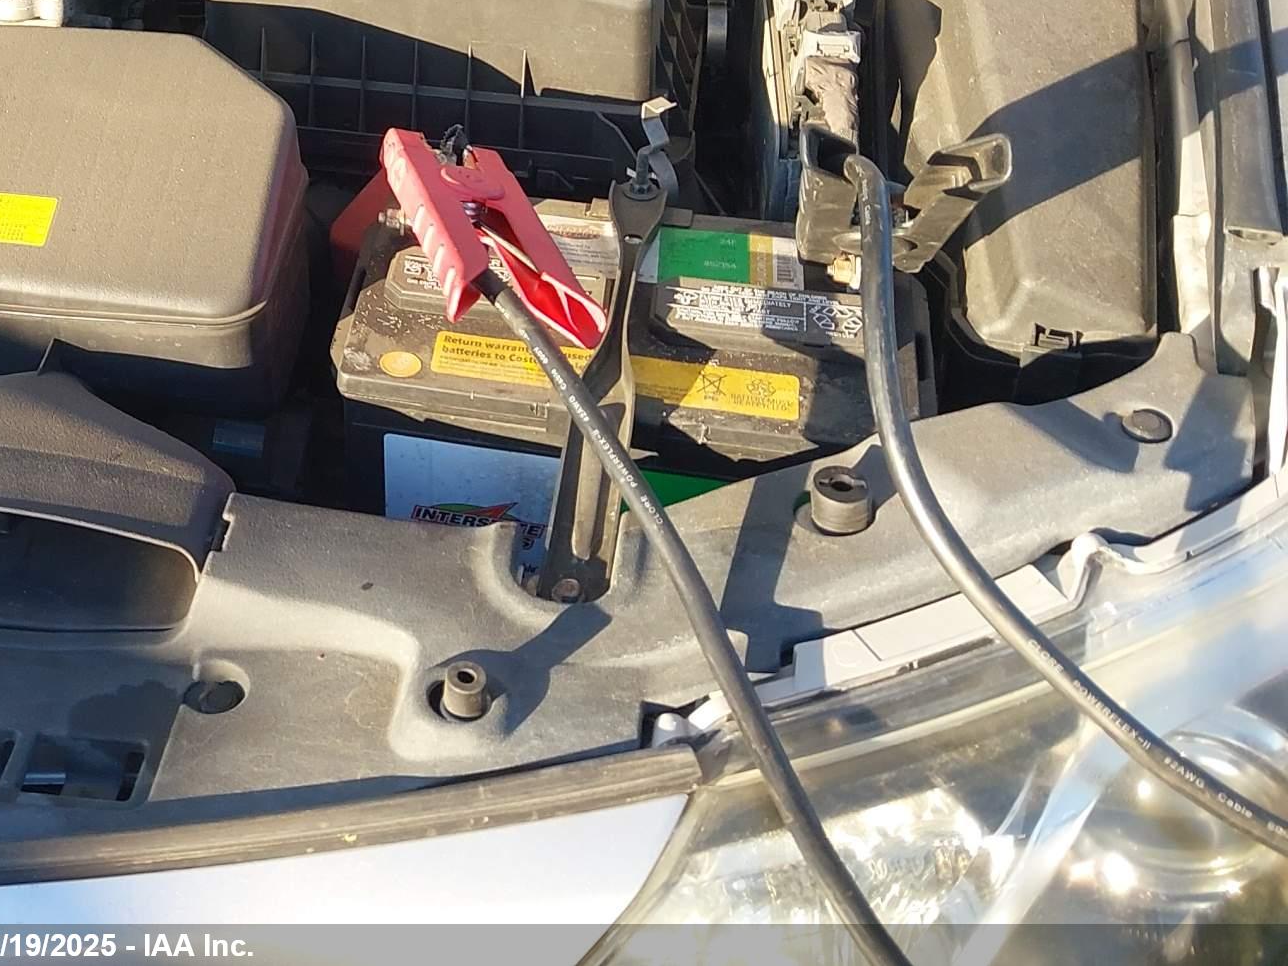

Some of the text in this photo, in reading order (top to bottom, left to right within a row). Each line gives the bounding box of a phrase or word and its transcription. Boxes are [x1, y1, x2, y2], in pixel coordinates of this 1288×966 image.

[442, 345, 492, 359] batteries
[495, 352, 506, 361] to
[444, 335, 482, 348] Return
[485, 342, 530, 354] warrant
[1218, 791, 1253, 819] Cable
